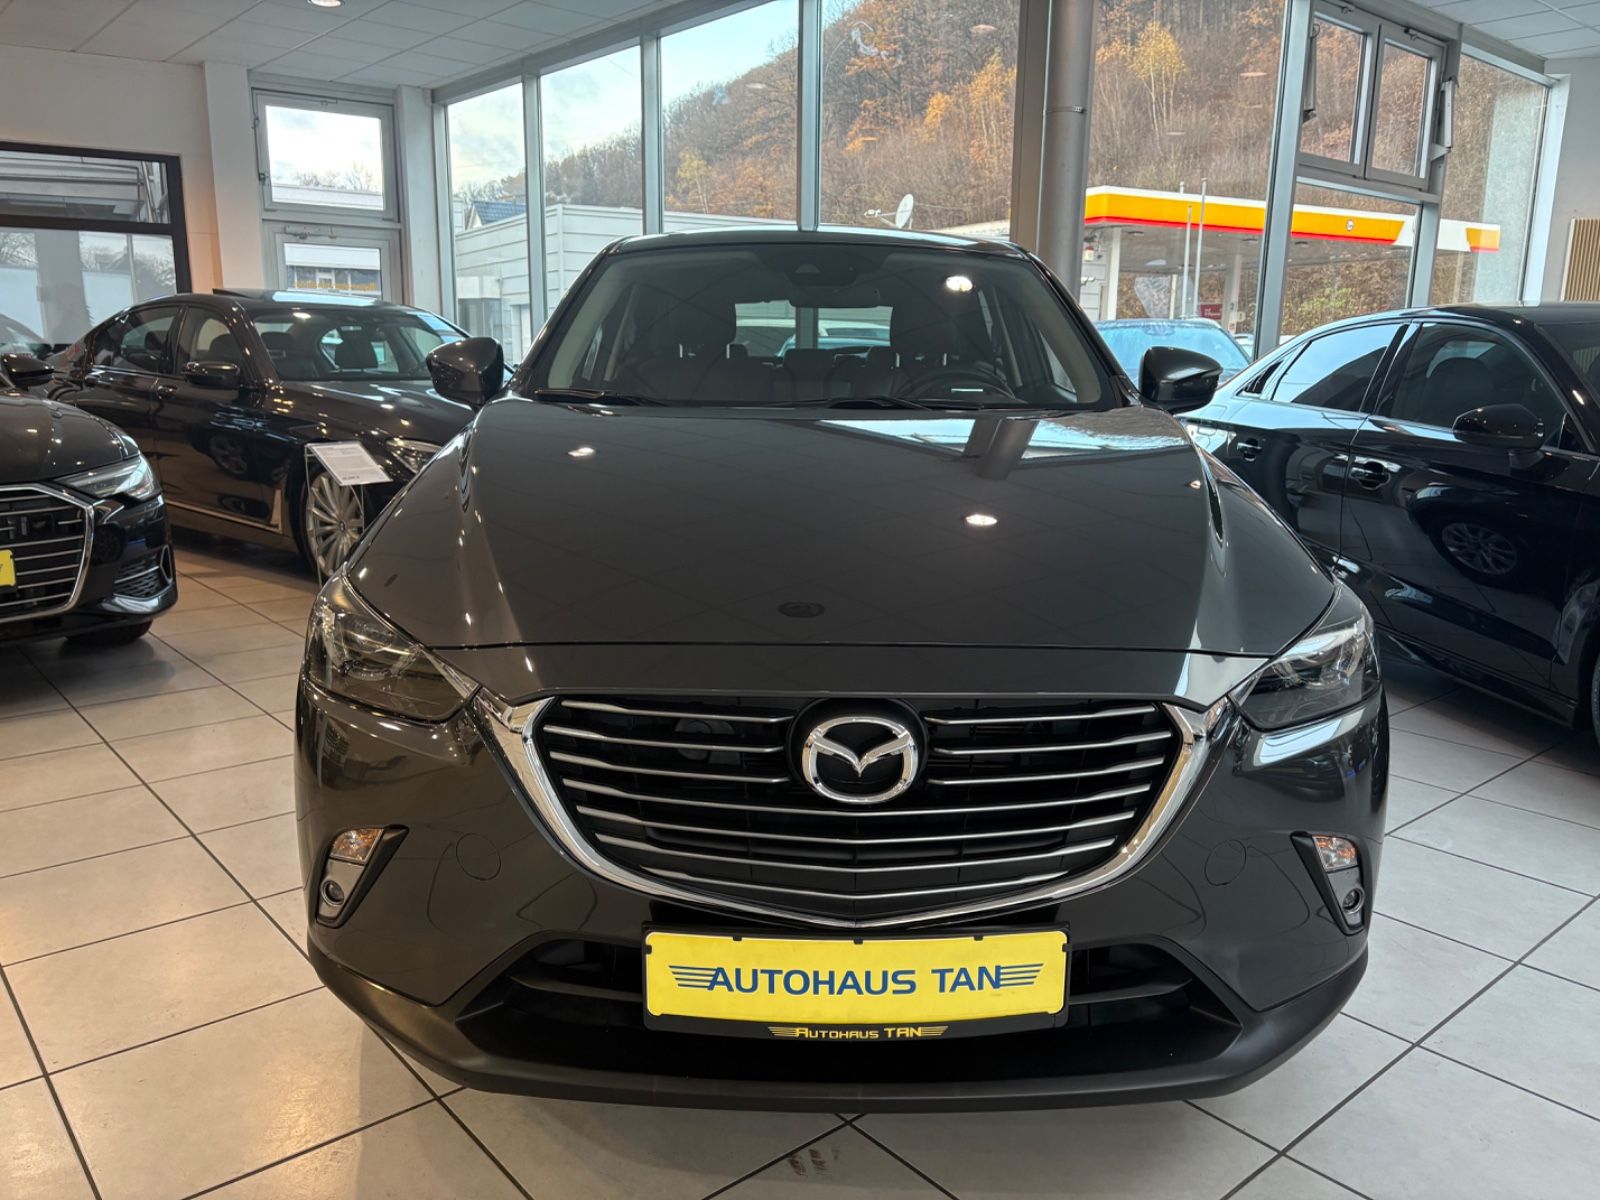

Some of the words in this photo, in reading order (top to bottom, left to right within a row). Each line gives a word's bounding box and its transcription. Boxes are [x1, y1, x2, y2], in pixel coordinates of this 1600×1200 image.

[707, 967, 917, 995] AUTOHAUS
[931, 965, 1001, 993] TAN
[884, 1026, 922, 1038] TAN
